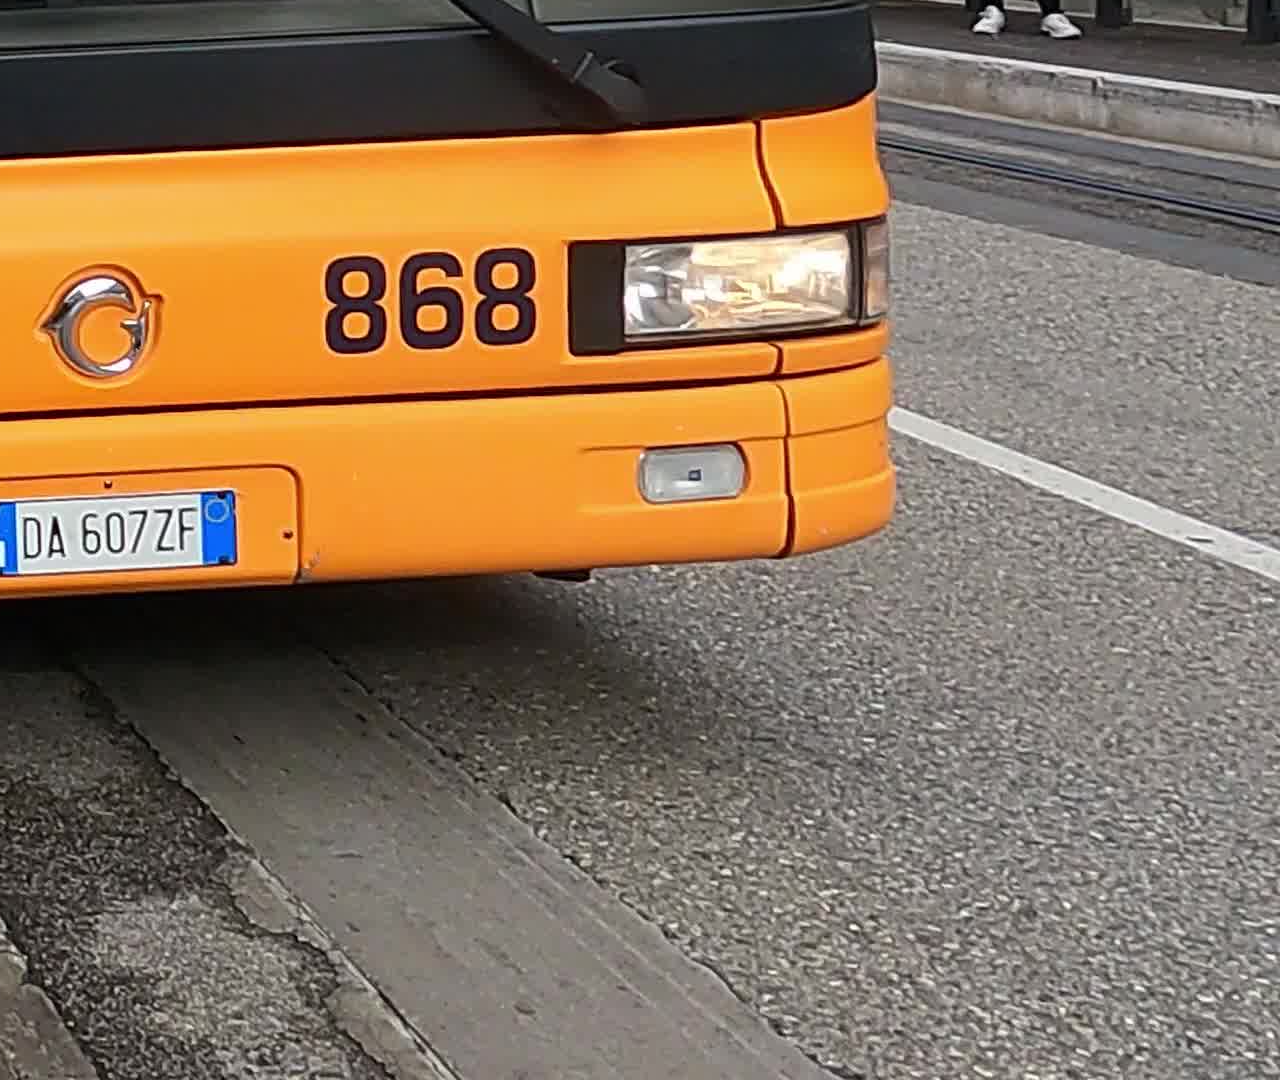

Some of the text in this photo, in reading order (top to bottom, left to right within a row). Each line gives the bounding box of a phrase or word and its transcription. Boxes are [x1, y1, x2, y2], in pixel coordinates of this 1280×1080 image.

[324, 247, 537, 355] 868
[22, 506, 199, 560] DA 607ZF
